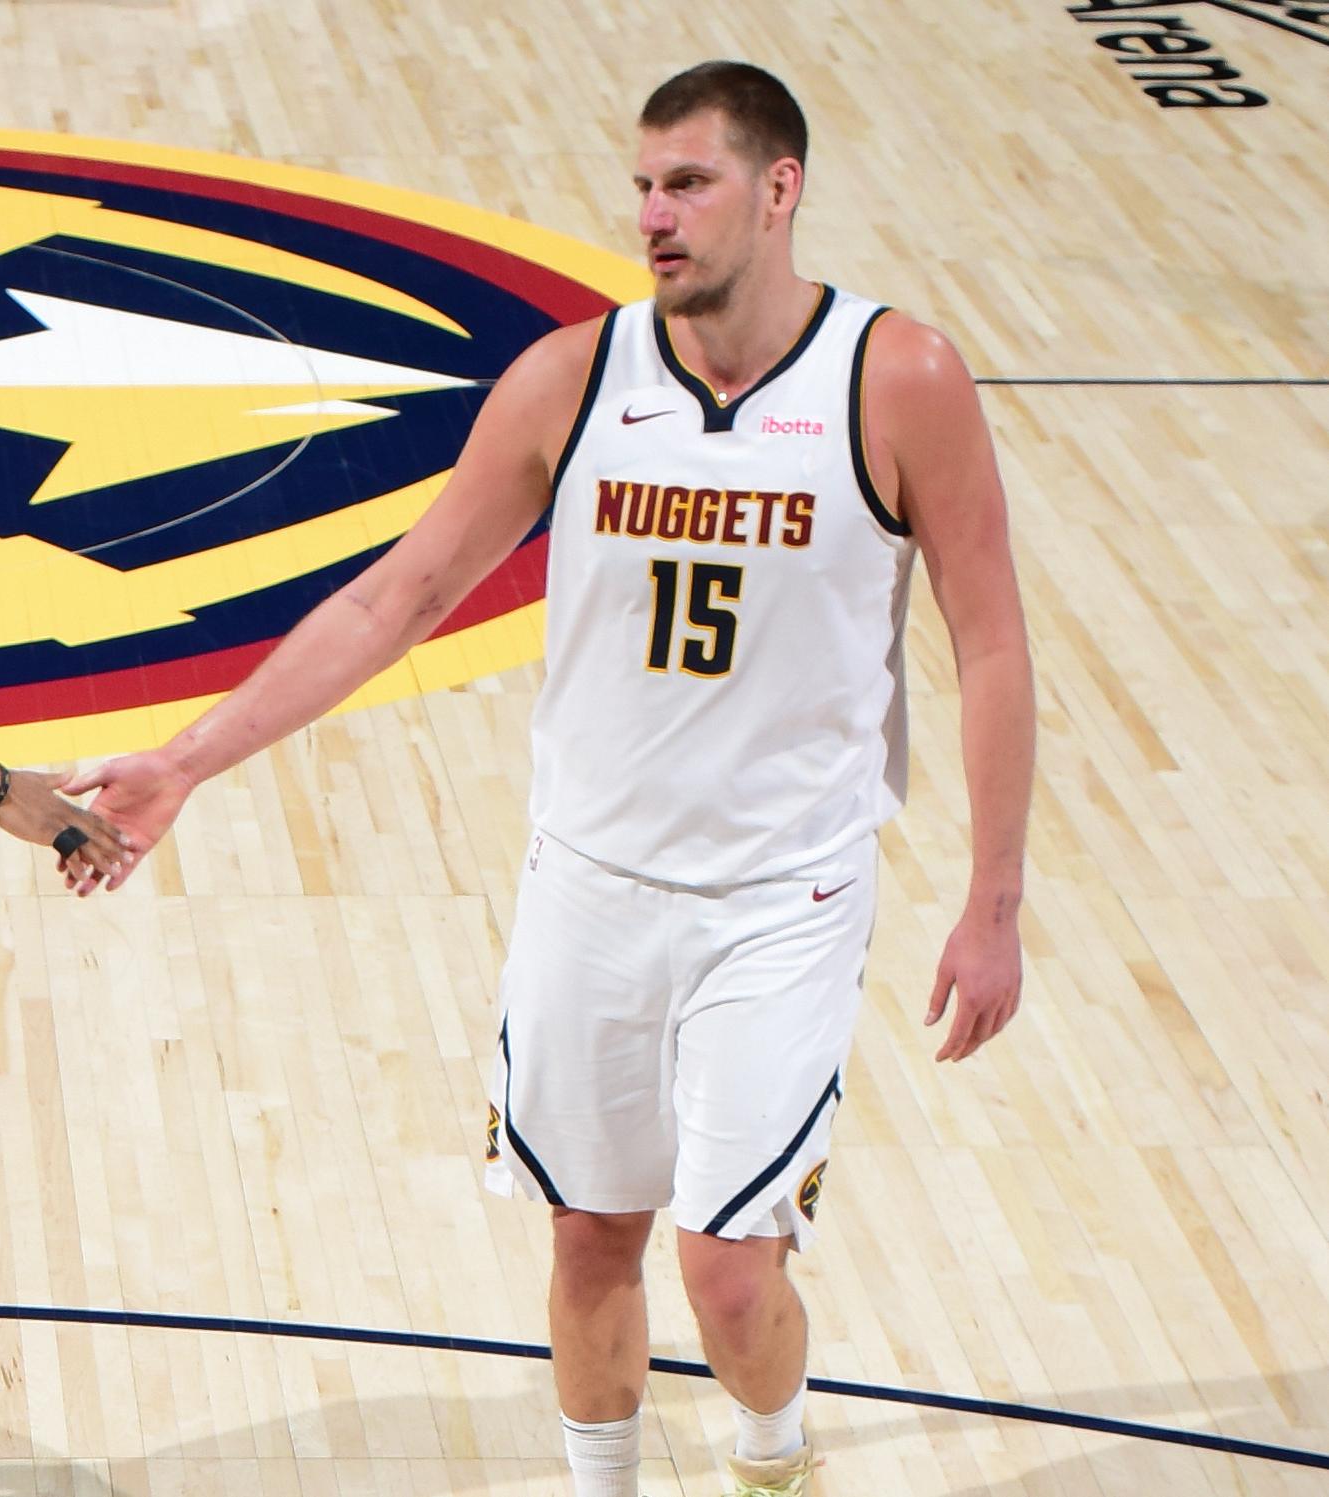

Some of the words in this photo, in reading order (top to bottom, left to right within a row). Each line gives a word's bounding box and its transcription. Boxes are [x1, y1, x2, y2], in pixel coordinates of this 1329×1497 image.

[761, 416, 824, 435] ibotta
[595, 478, 817, 549] NUGGETS
[644, 558, 745, 680] 15
